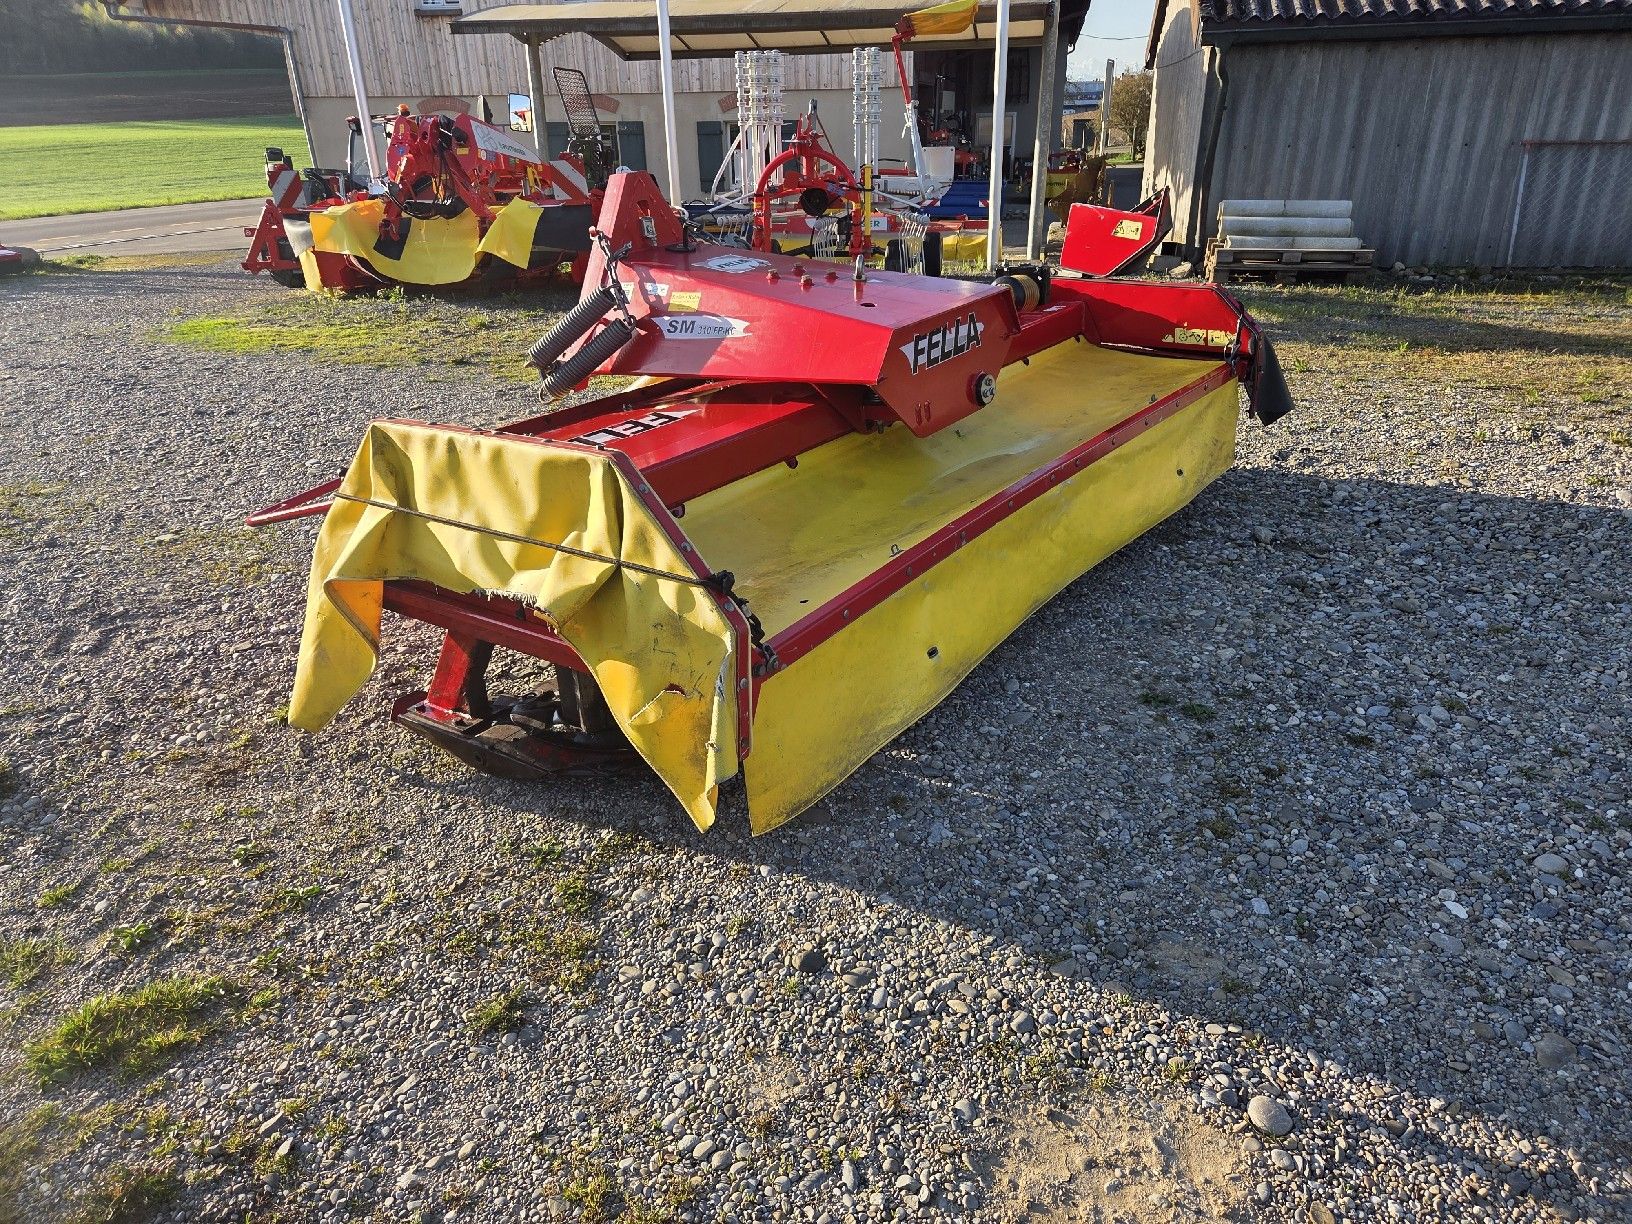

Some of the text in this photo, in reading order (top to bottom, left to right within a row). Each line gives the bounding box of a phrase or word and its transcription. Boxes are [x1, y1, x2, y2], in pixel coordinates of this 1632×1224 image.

[666, 319, 697, 334] SM
[697, 326, 712, 335] 310
[912, 311, 981, 375] FELLA
[567, 411, 682, 447] FELL
